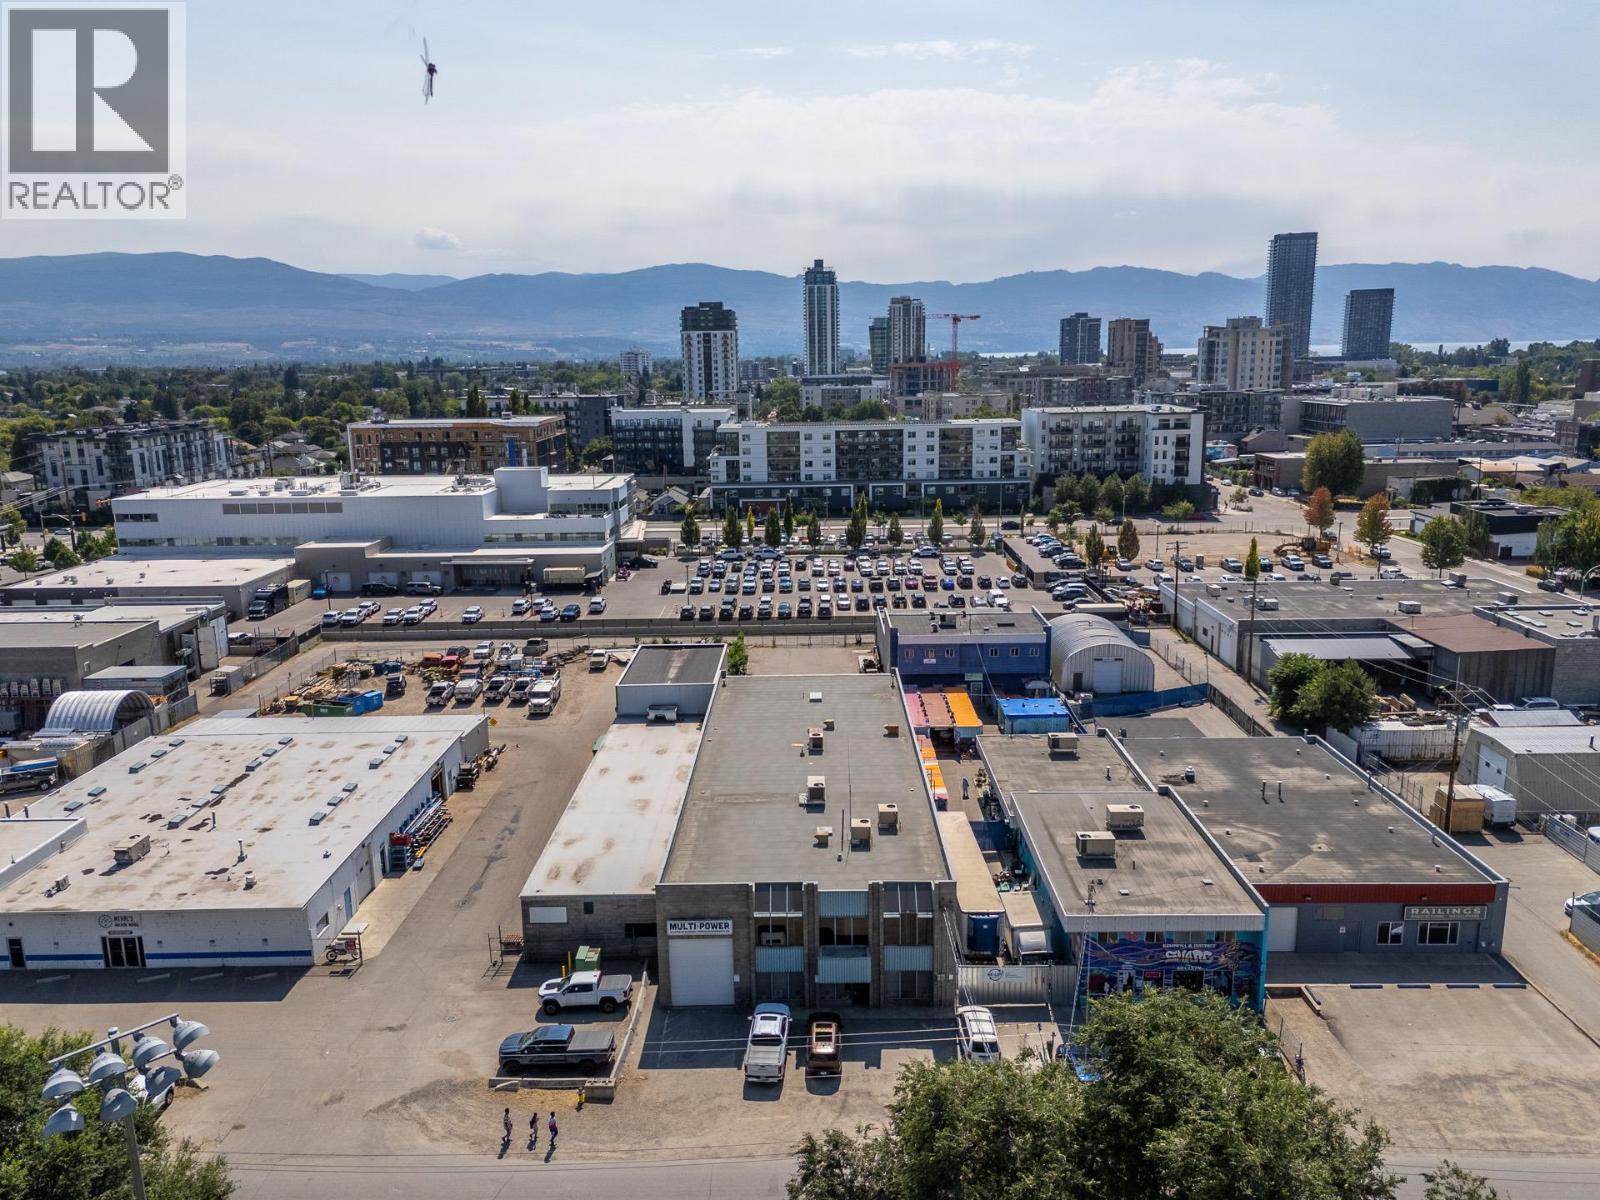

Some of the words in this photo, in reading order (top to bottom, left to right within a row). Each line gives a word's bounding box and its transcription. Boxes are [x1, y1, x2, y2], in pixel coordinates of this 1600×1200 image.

[1410, 907, 1481, 915] RAILINGS
[669, 922, 697, 930] MULTI
[699, 922, 730, 930] POWER
